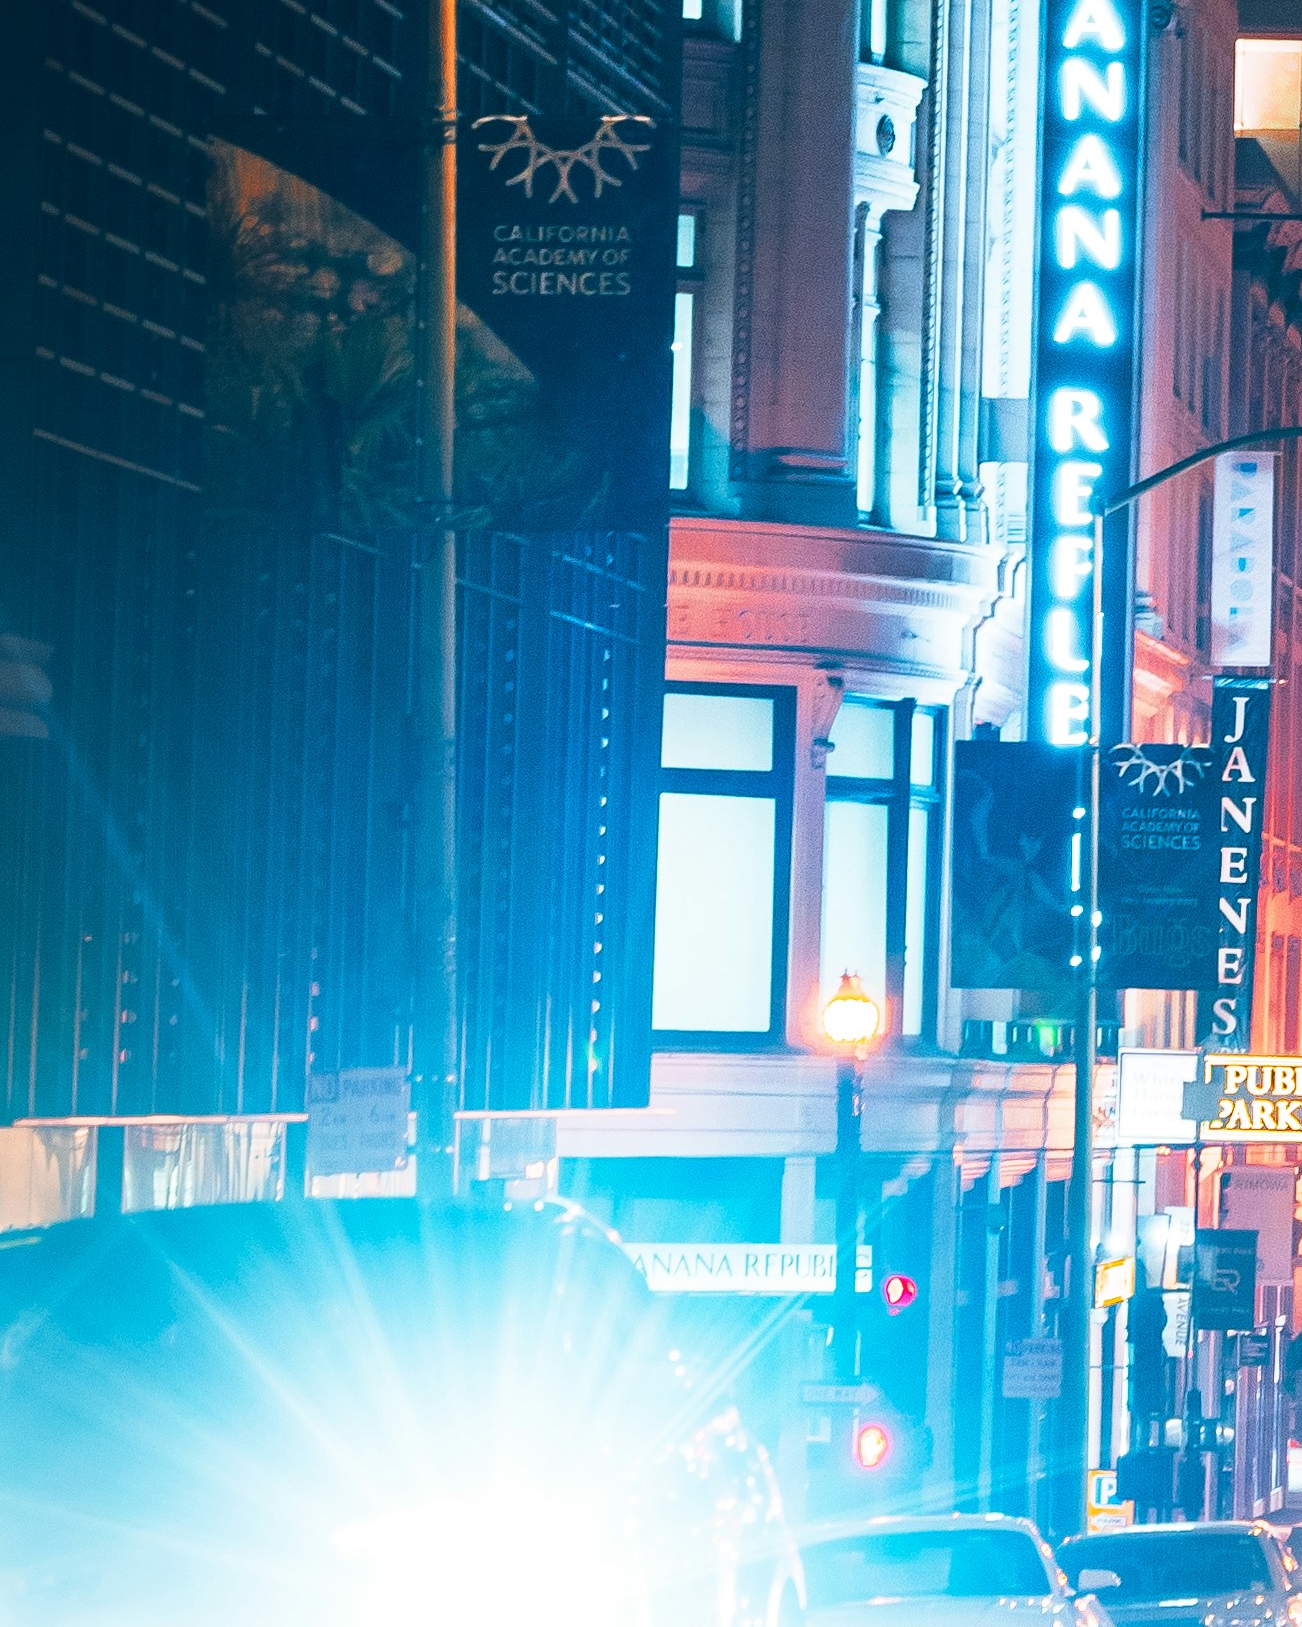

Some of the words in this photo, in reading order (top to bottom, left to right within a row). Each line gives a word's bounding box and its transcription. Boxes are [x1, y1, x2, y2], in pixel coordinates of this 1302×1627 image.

[493, 224, 631, 243] CALIFORNIA
[492, 247, 600, 266] ACADEMY
[602, 247, 631, 266] OF
[492, 270, 632, 295] SCIENCES
[1121, 807, 1200, 819] CALIFORNIA
[1120, 821, 1179, 833] ACADEMY
[1182, 821, 1200, 833] OF
[1121, 835, 1201, 851] SCIENCES
[633, 1253, 733, 1278] ANANA
[1175, 1297, 1189, 1346] AVENUE
